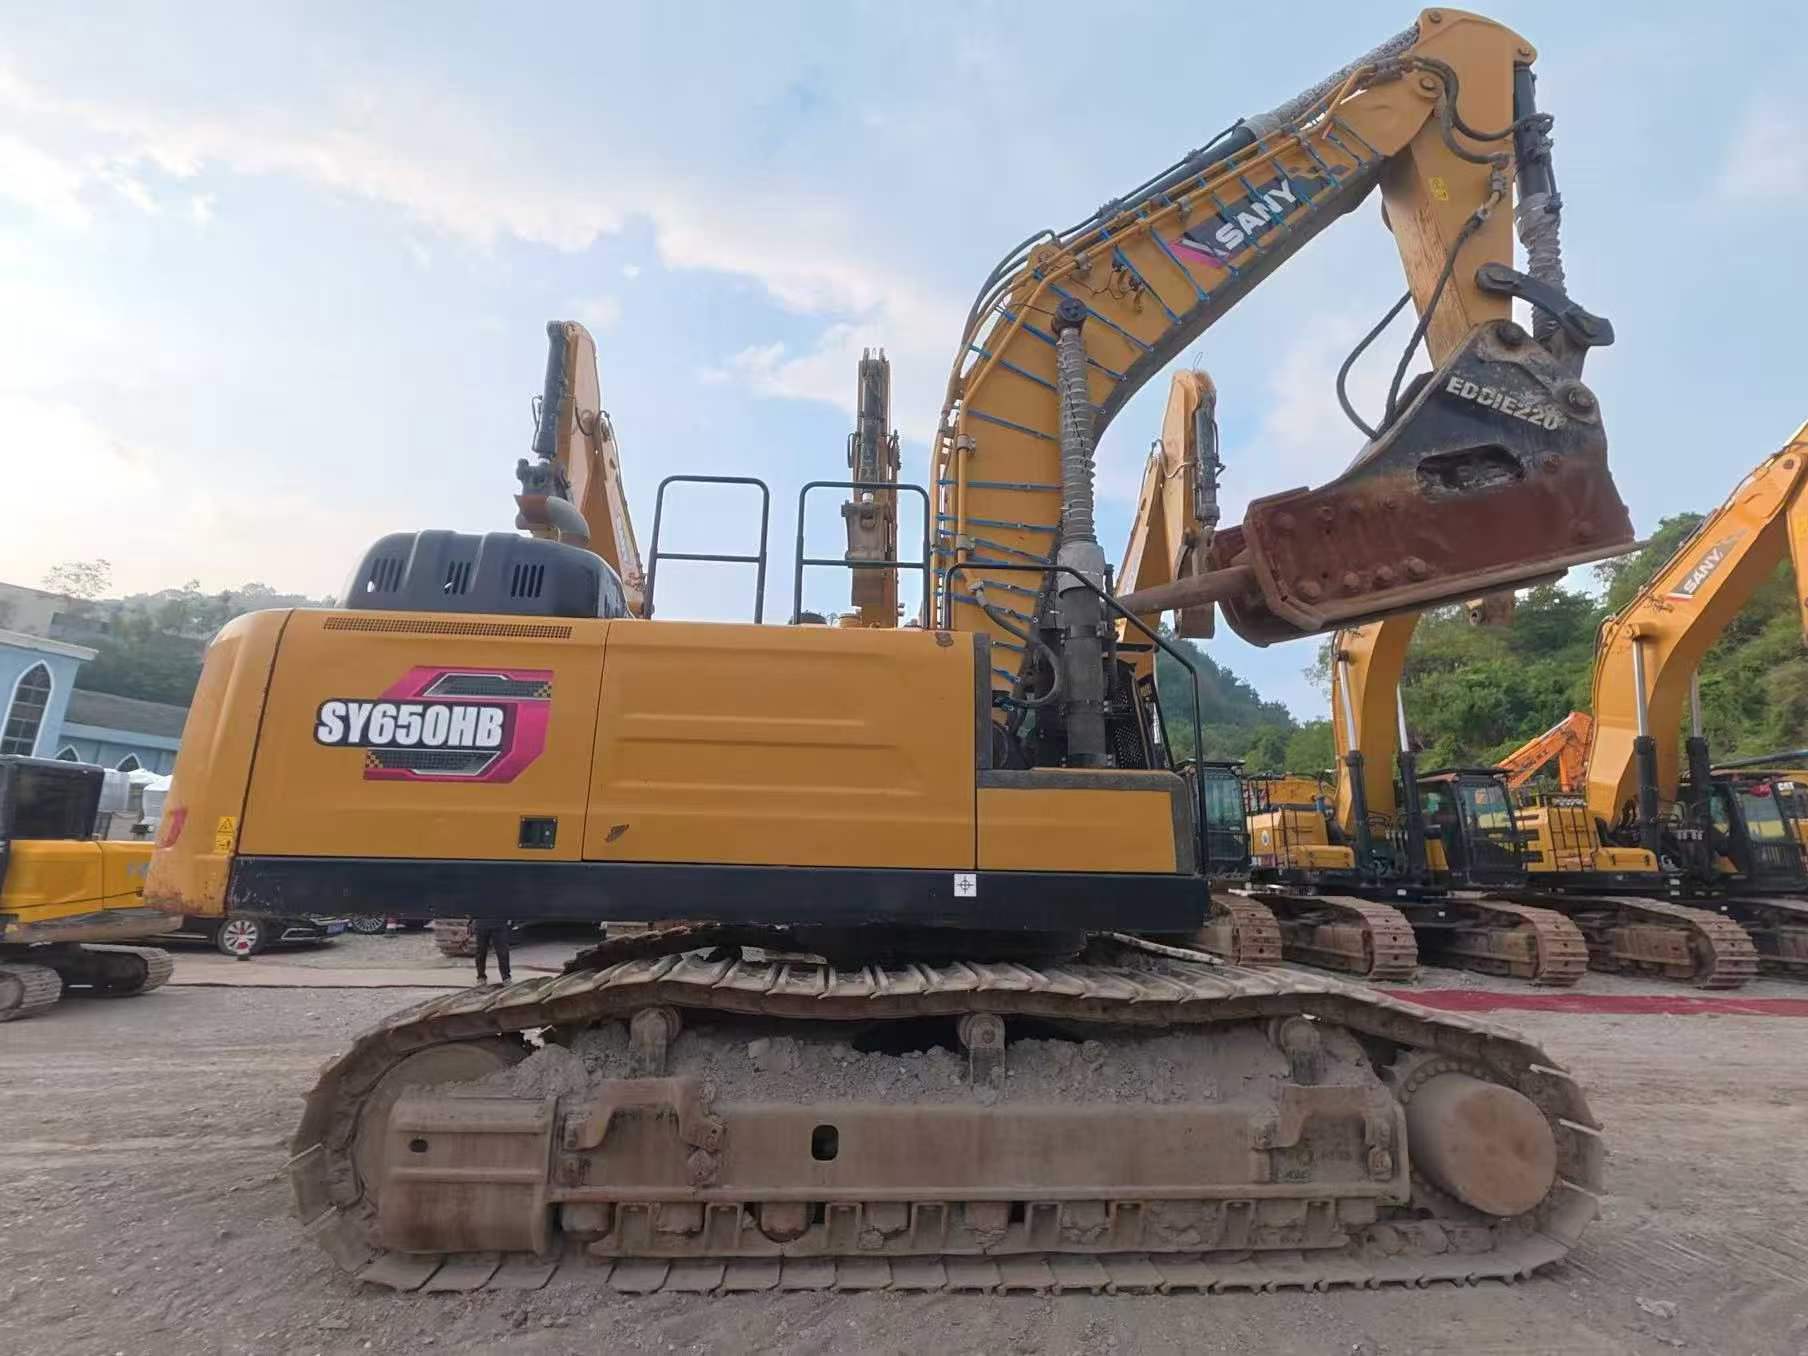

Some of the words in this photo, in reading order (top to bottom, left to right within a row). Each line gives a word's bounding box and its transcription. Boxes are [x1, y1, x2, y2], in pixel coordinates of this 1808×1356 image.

[1215, 178, 1297, 250] SANY
[1683, 548, 1723, 594] SANY
[316, 700, 505, 747] SY650HB
